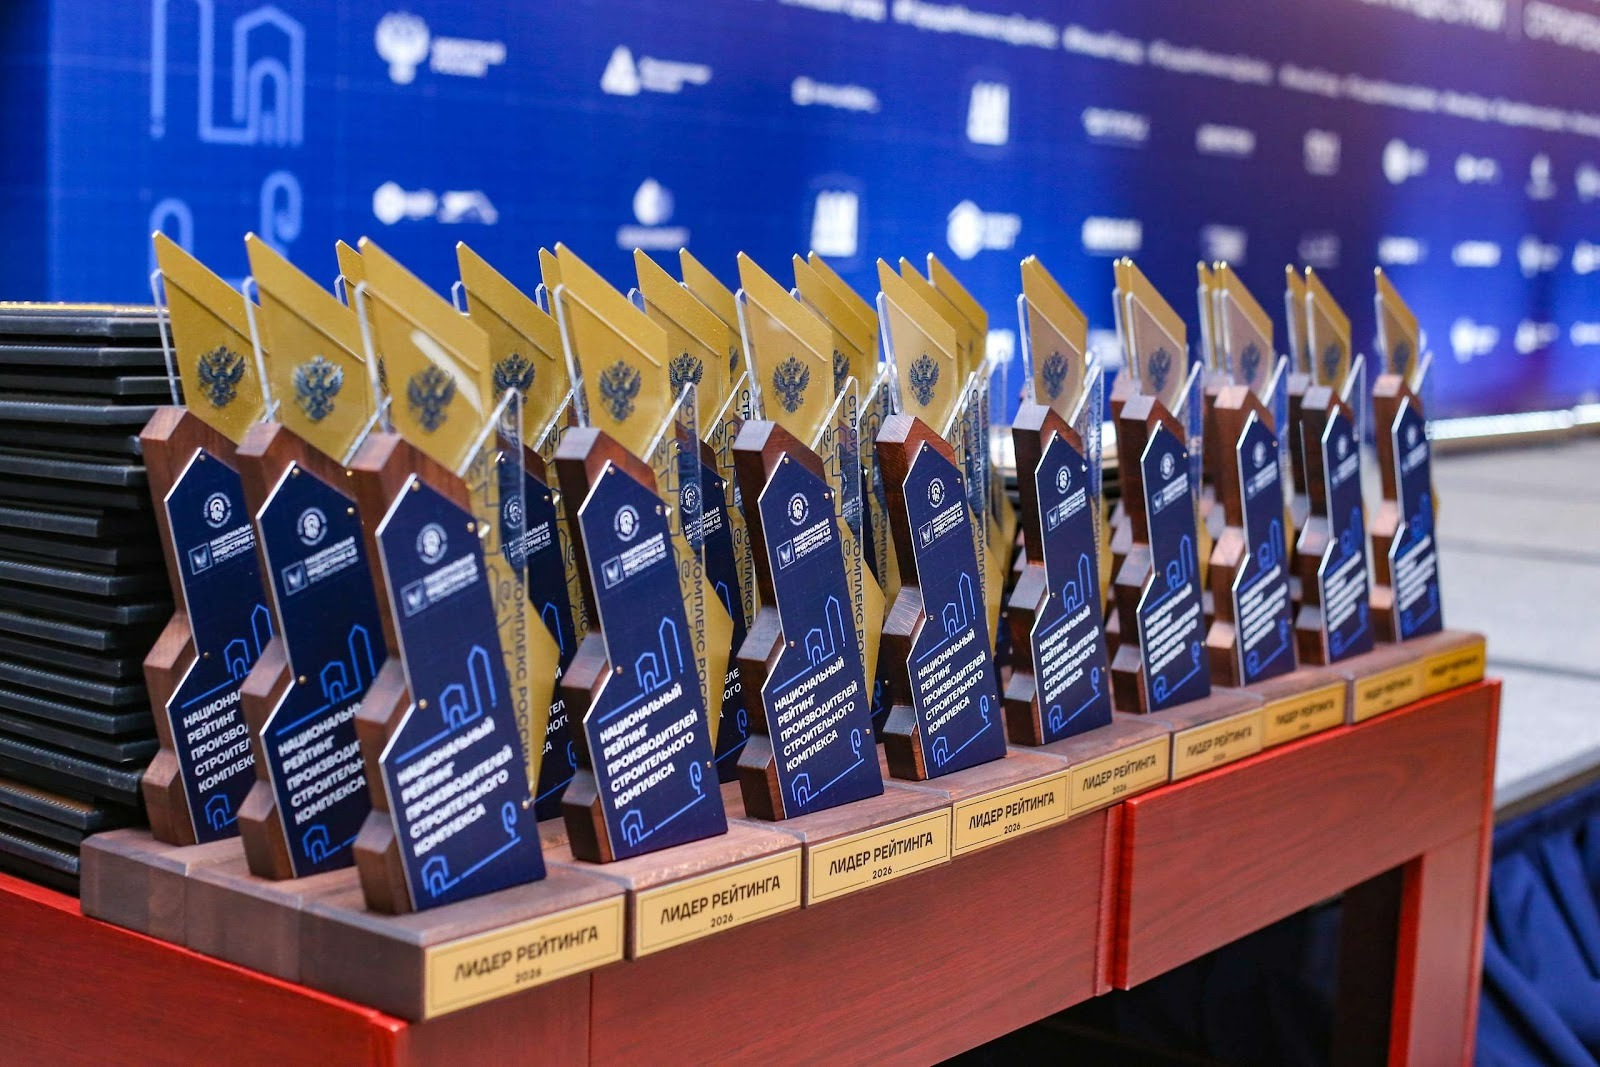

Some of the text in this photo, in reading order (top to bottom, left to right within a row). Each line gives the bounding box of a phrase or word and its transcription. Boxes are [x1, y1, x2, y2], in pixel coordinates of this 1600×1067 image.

[918, 628, 976, 680] НАЦИОНАЛЬНЫЙ
[774, 656, 845, 712] НАЦИОНАЛЬНЫЙ
[920, 663, 951, 693] РЕЙТИНГ
[923, 650, 986, 707] ПРОИЗВОДИТЕЛЕЙ
[925, 670, 984, 721] СТРОИТЕЛЬНОГО
[187, 709, 236, 744] РЕЙТИНГ
[599, 682, 683, 744] НАЦИОНАЛЬНЫЙ
[777, 693, 816, 727] РЕЙТИНГ
[780, 680, 858, 742] ПРОИЗВОДИТЕЛЕЙ
[783, 701, 855, 757] СТРОИТЕЛЬНОГО
[927, 696, 971, 735] КОМПЛЕКСА
[282, 735, 335, 774] РЕЙТИНГ
[603, 723, 648, 760] РЕЙТИНГ
[607, 708, 698, 777] ПРОИЗВОДИТЕЛЕЙ
[610, 731, 694, 793] СТРОИТЕЛЬНОГО
[786, 729, 839, 772] КОМПЛЕКСА
[295, 775, 366, 825] КОМПЛЕКСА
[614, 762, 675, 809] КОМПЛЕКСА
[1082, 770, 1112, 791] ЛИДЕР
[969, 791, 1055, 830] ЛИДЕР РЕЙТИНГА
[1004, 822, 1021, 834] 2026
[829, 831, 933, 875] ЛИДЕР РЕЙТИНГА
[872, 865, 893, 880] 2026
[660, 875, 780, 925] ЛИДЕР РЕЙТИНГА
[710, 913, 734, 928] 2026
[454, 925, 598, 982] ЛИДЕР РЕЙТИНГА
